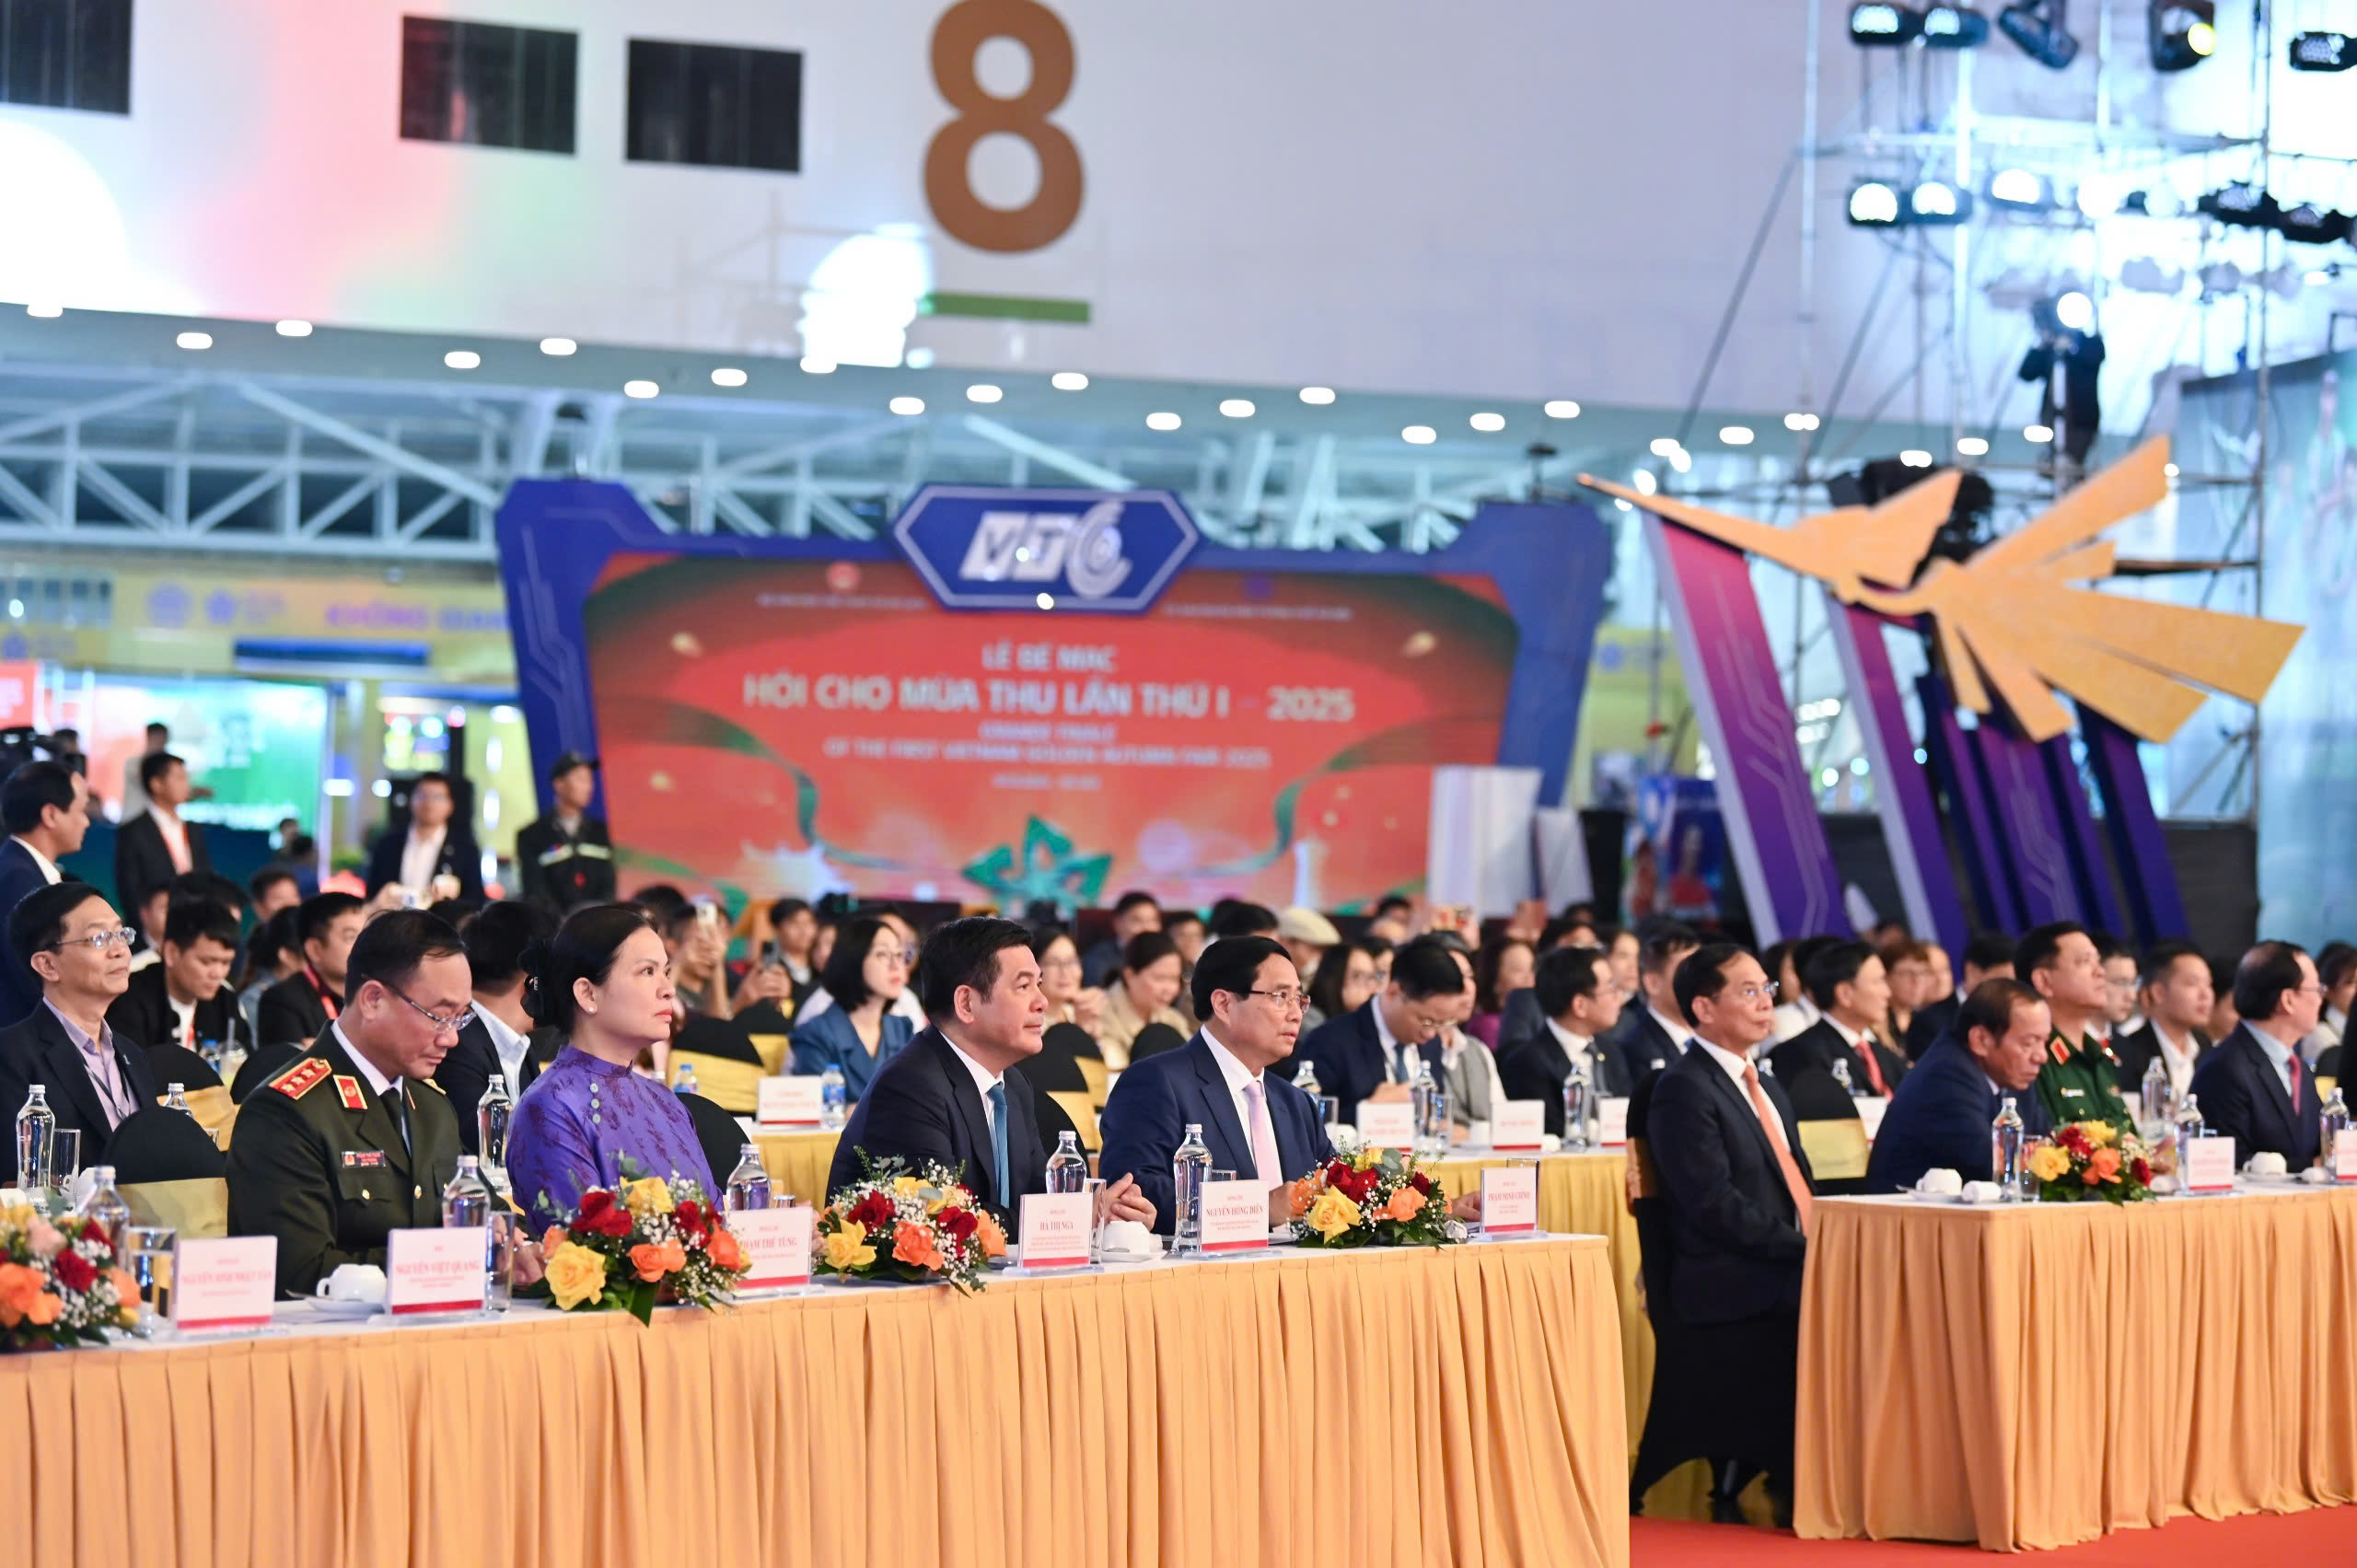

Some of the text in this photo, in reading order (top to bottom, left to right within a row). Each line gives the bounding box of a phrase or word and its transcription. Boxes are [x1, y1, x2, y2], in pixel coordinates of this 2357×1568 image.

[922, 0, 1085, 253] 8
[988, 678, 1057, 714] THU
[1267, 685, 1355, 723] 2025
